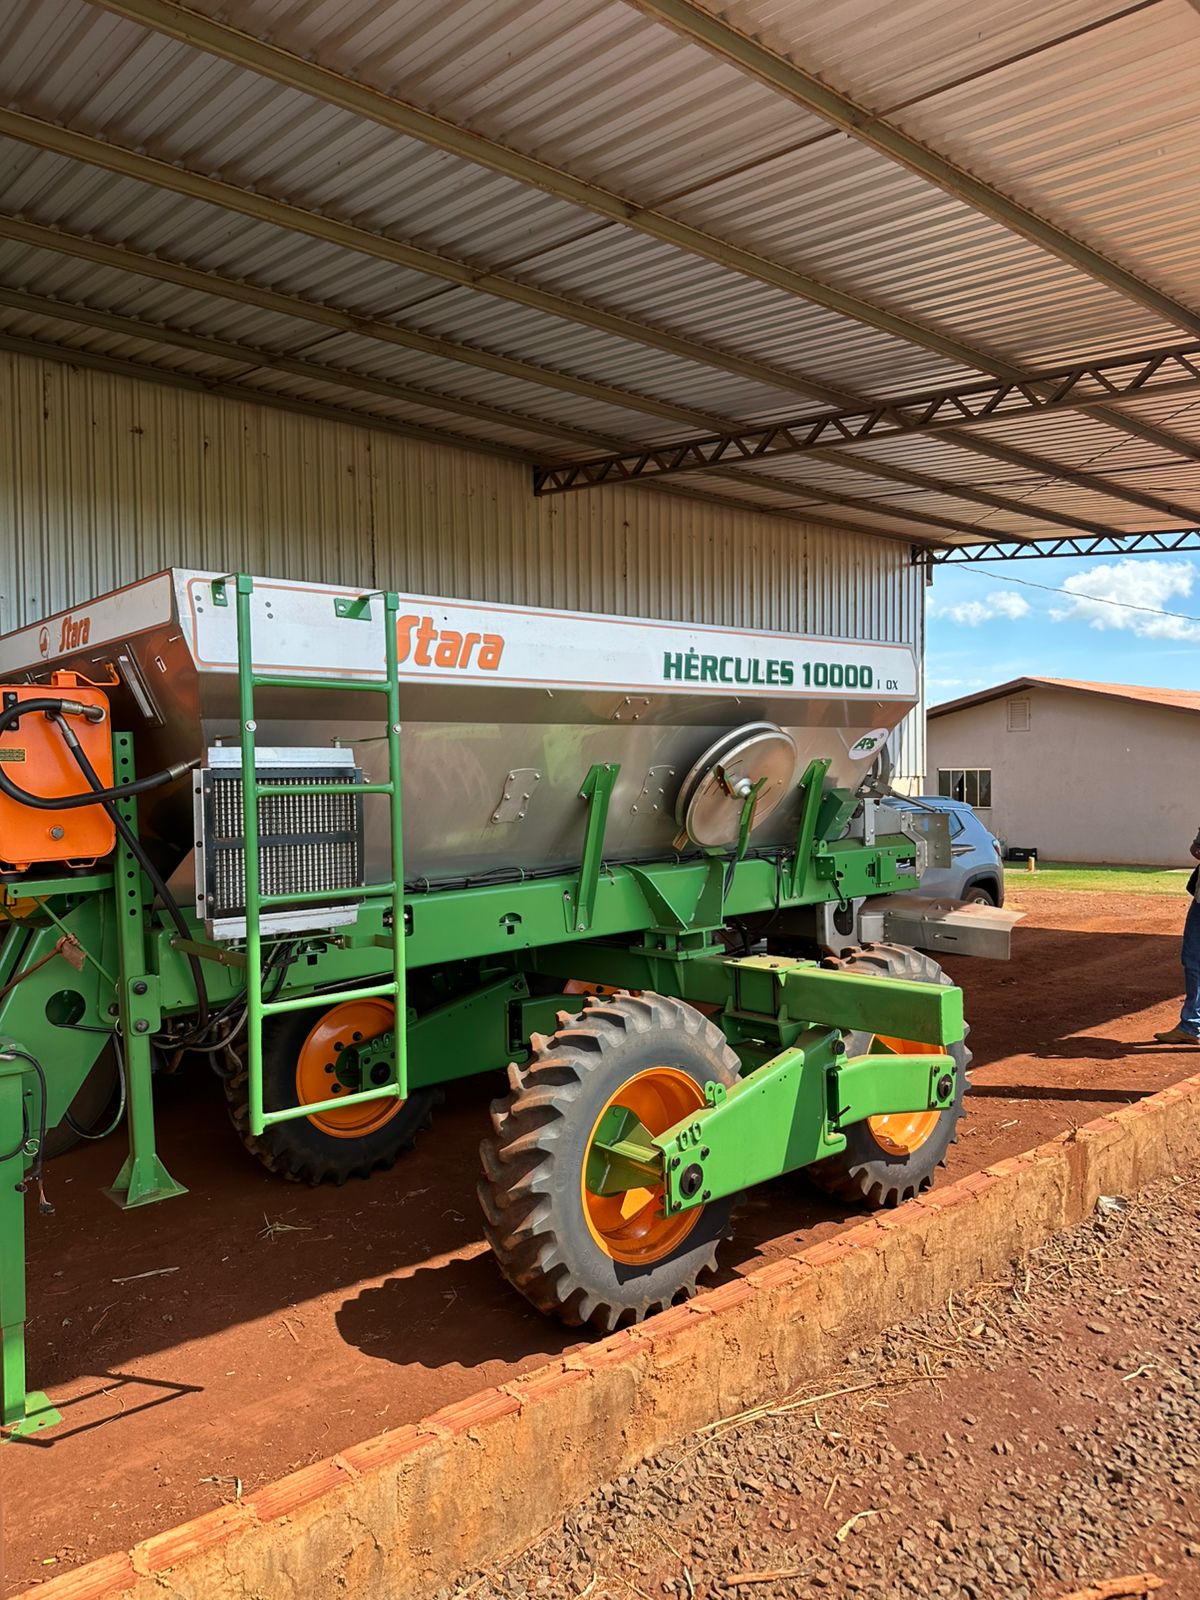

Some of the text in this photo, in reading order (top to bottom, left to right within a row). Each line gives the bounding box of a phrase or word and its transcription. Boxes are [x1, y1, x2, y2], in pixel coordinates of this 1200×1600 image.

[59, 615, 90, 653] Stara
[385, 614, 505, 671] Stara
[802, 662, 873, 689] 10000
